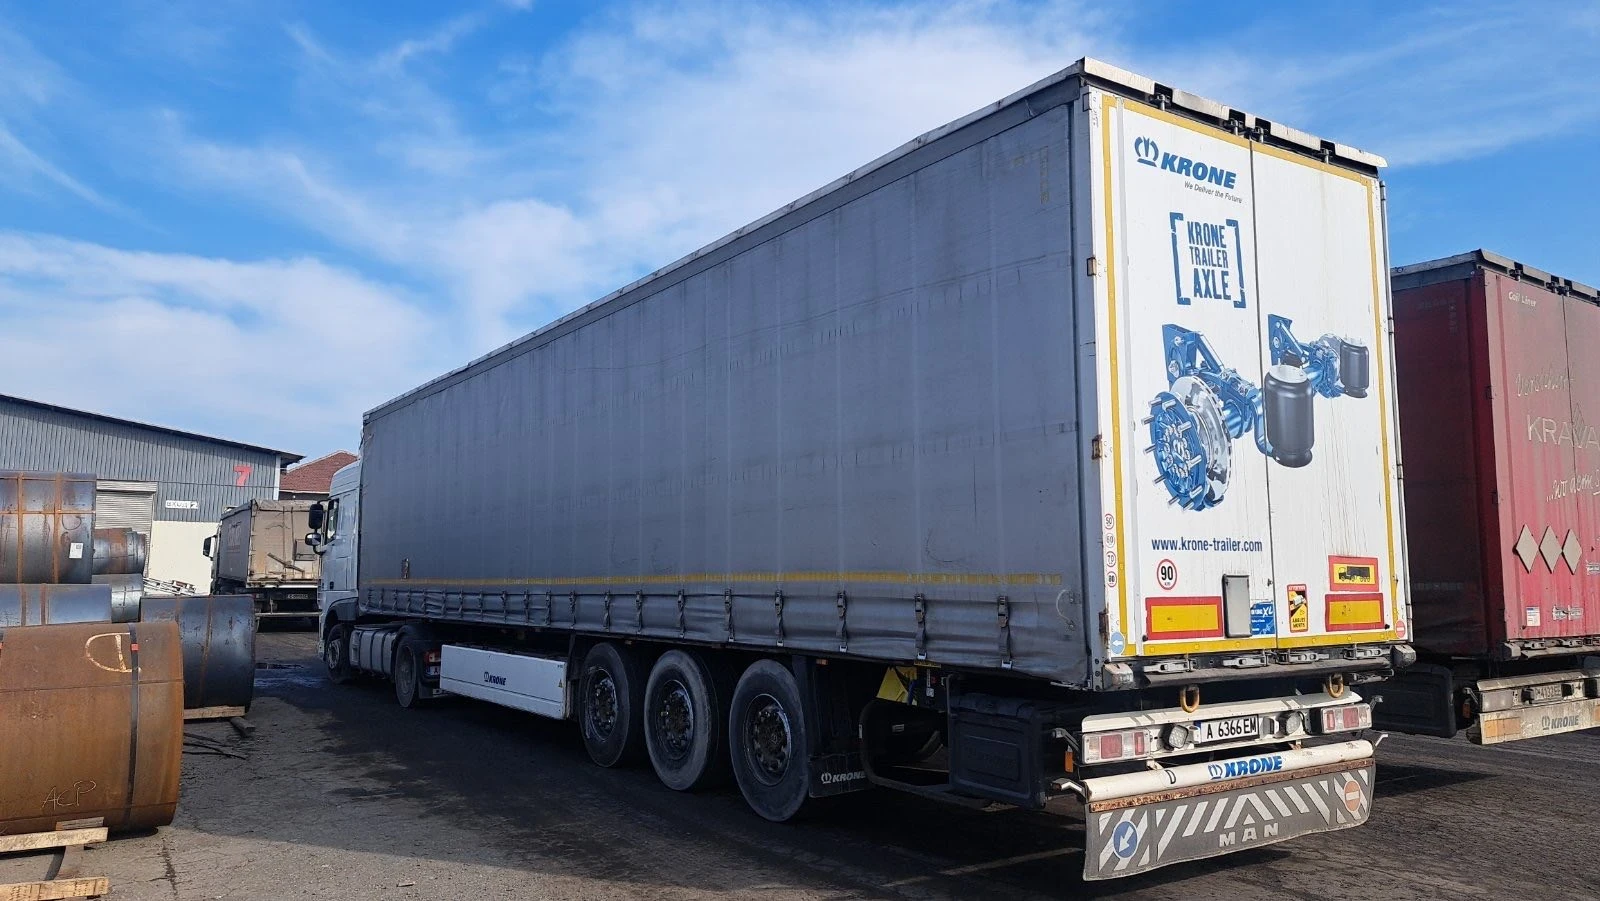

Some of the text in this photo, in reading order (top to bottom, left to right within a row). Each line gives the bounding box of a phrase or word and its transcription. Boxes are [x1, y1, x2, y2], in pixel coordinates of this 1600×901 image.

[1160, 151, 1237, 189] KRONE
[1184, 180, 1243, 204] We Deliver the Future
[1187, 221, 1227, 248] KRONE
[1189, 246, 1229, 269] TRAILER
[1193, 270, 1232, 300] AXLE
[234, 466, 251, 486] 7
[1105, 516, 1112, 525] 50
[1151, 537, 1263, 552] www.krone-trailer.com
[1107, 554, 1115, 563] 70
[1160, 565, 1174, 581] 90
[1262, 606, 1273, 618] XL
[489, 674, 507, 686] KRONE
[1551, 716, 1579, 729] KRONE
[1206, 723, 1214, 739] A
[1224, 755, 1282, 778] KRONE
[832, 771, 866, 783] KRONE
[1219, 822, 1279, 848] MAN
